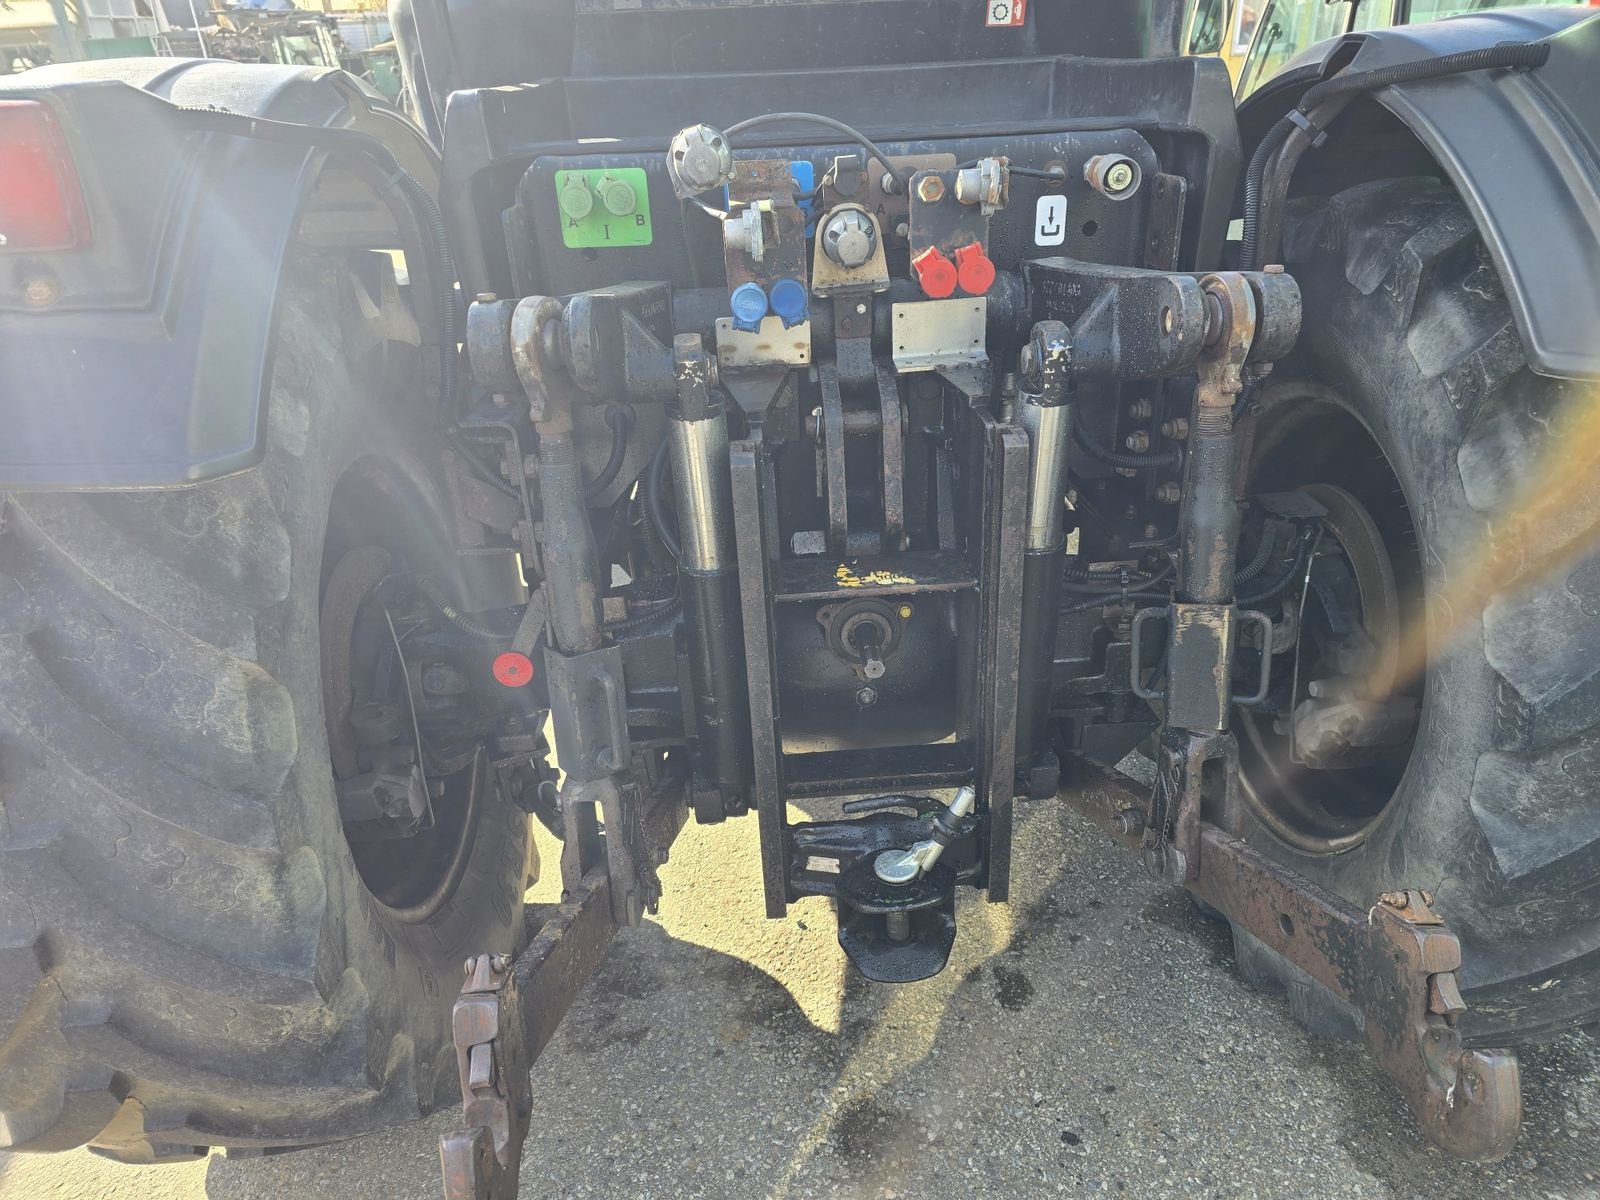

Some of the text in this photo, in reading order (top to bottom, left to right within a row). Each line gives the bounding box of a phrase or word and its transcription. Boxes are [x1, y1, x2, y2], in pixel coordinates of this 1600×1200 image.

[876, 203, 886, 215] A
[569, 217, 579, 228] A
[636, 214, 645, 226] B
